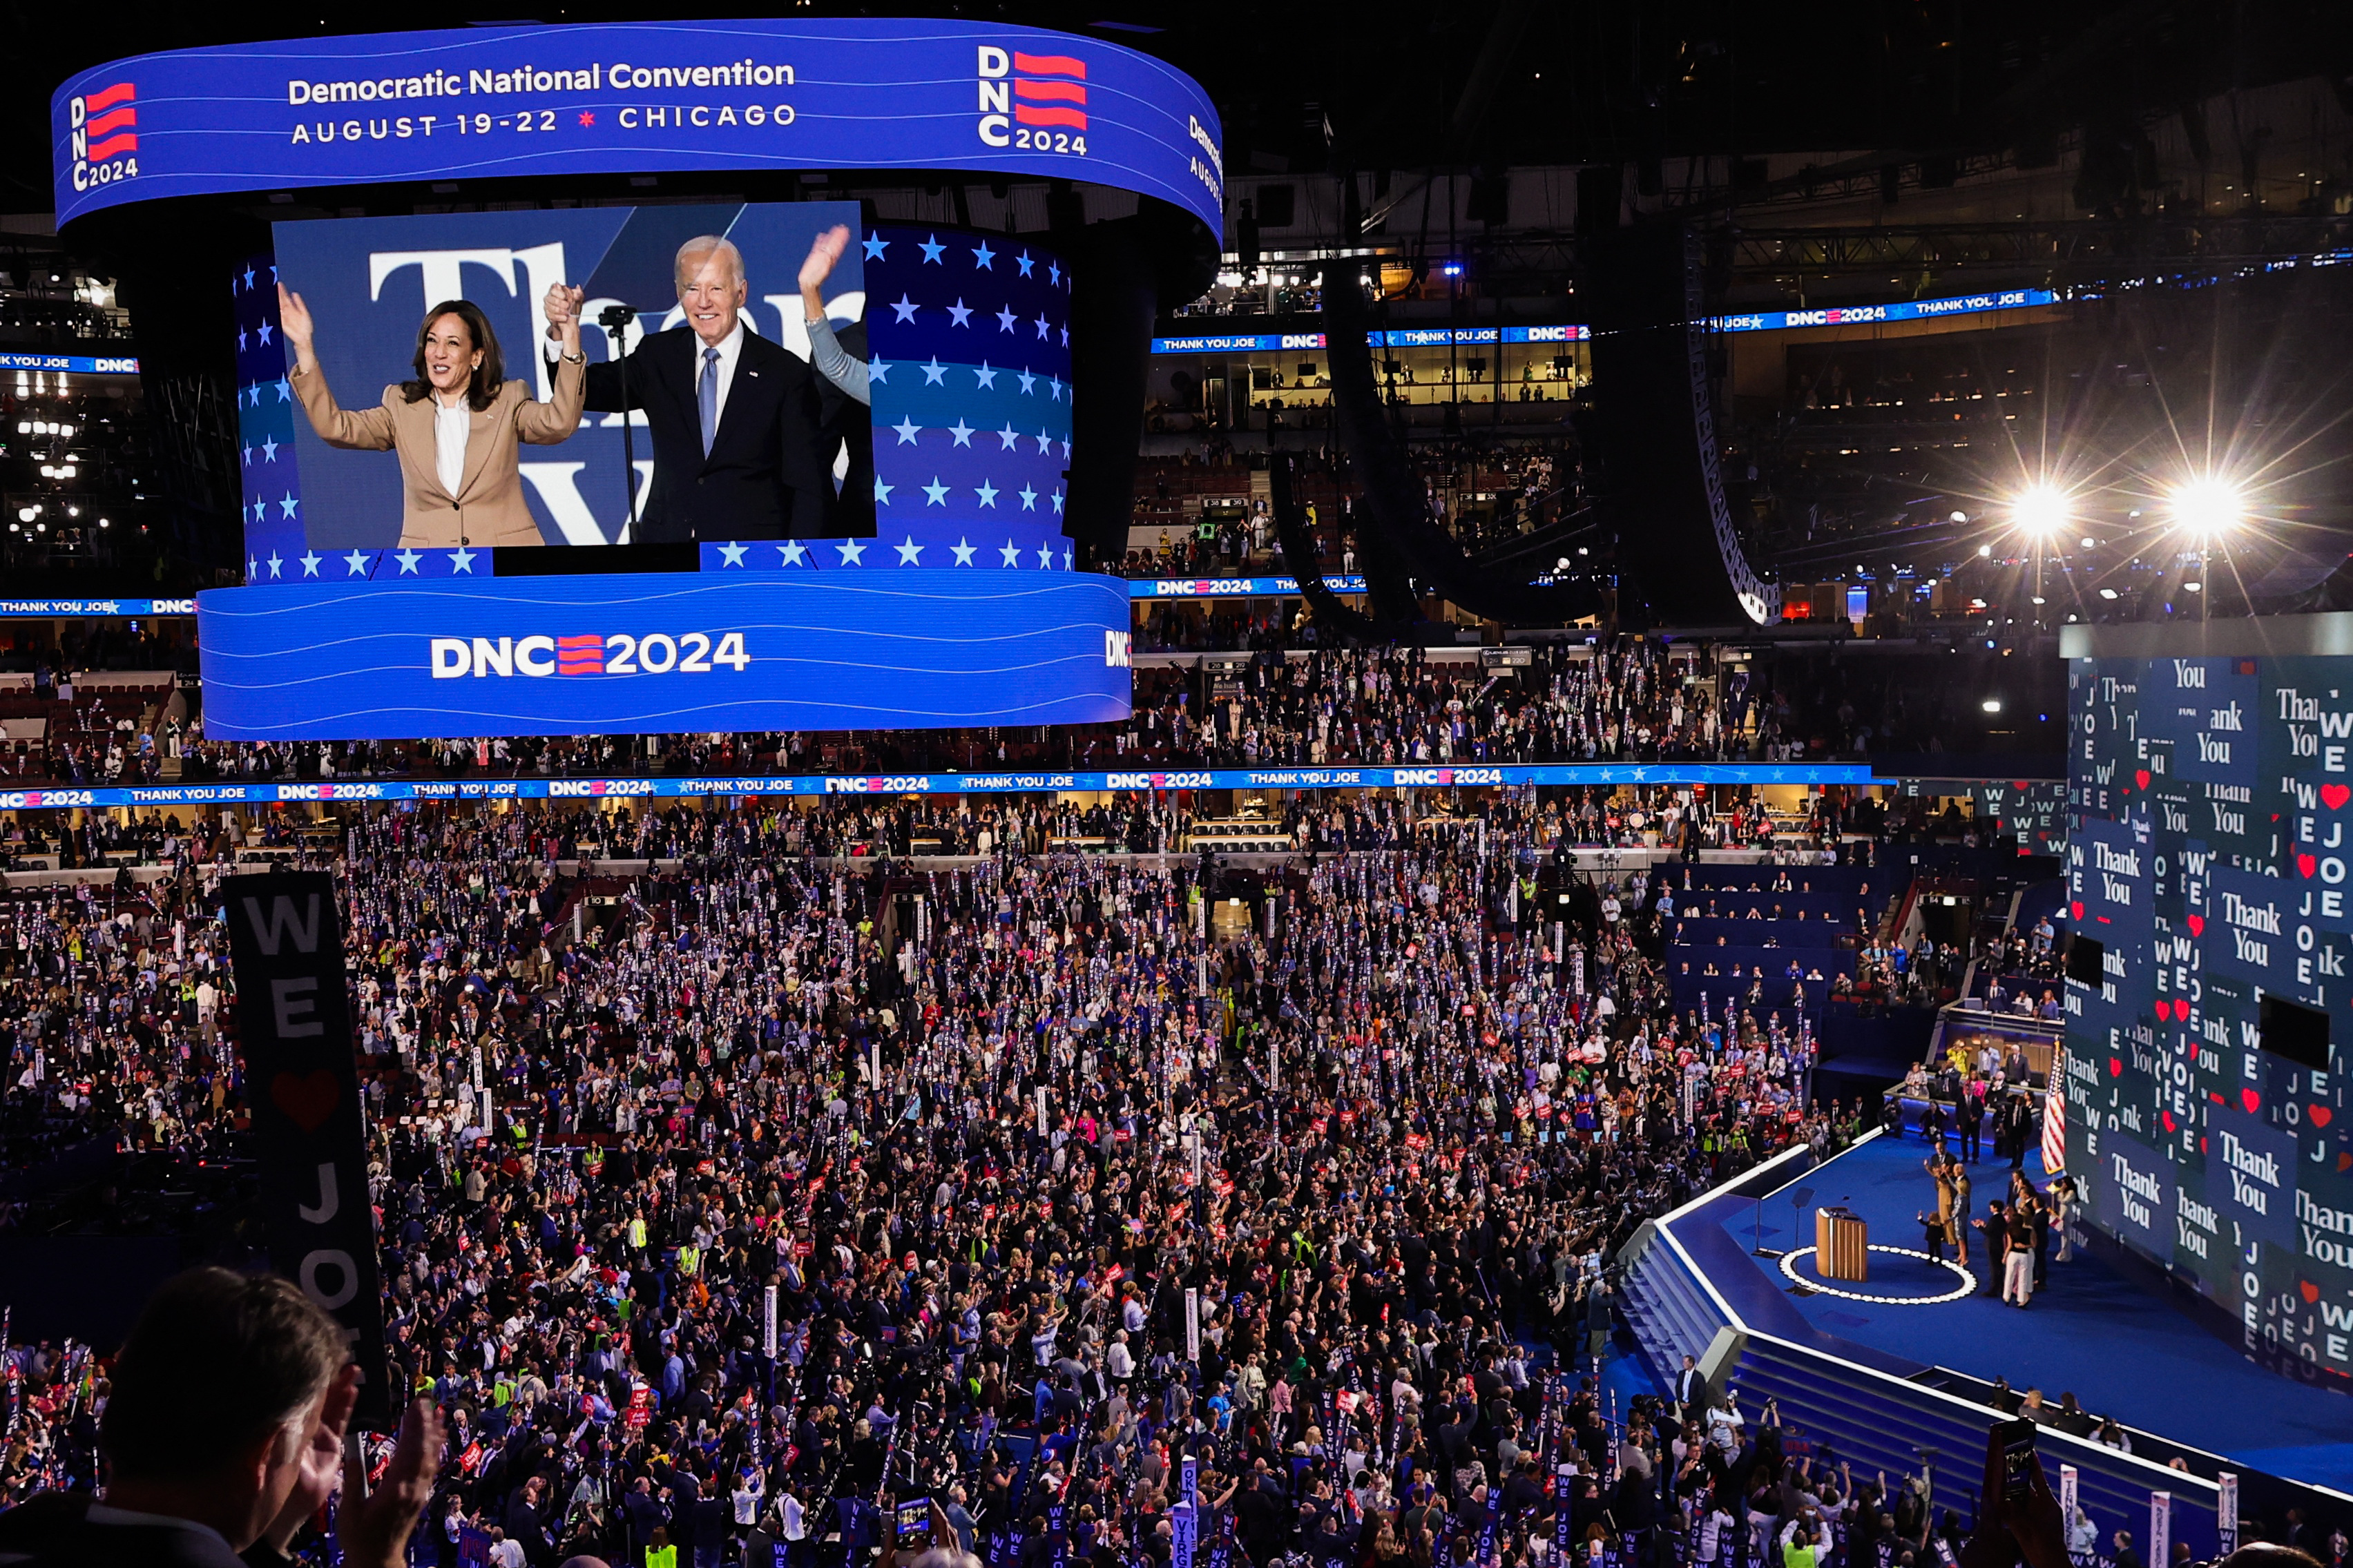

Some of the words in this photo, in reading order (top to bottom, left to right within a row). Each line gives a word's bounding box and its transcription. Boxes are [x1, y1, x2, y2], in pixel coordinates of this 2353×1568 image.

[289, 69, 461, 105] Democratic
[469, 63, 600, 95] National
[608, 58, 794, 89] Convention
[291, 116, 436, 144] AUGUST
[457, 110, 556, 135] 19-22
[619, 104, 795, 128] CHICAGO
[1016, 128, 1087, 156] 2024
[89, 158, 138, 186] 2024
[1725, 317, 1751, 329] JOE
[1786, 311, 1827, 327] DNC
[1916, 300, 1963, 313] THANK
[1998, 293, 2024, 305] JOE
[1164, 339, 1204, 349] THANK
[1205, 338, 1231, 348] YOU
[1232, 338, 1256, 347] JOE
[1282, 334, 1318, 348] DNC
[1405, 331, 1446, 342] THANK
[1475, 330, 1497, 340] JOE
[1528, 327, 1566, 340] DNC
[12, 356, 41, 367] YOU
[44, 358, 69, 368] JOE
[95, 358, 135, 372] DNC
[1156, 580, 1195, 594] DNC
[1209, 579, 1253, 593] 2024
[0, 602, 49, 612] THANK
[51, 601, 82, 612] YOU
[84, 601, 110, 612] JOE
[152, 599, 193, 613] DNC
[431, 635, 555, 679] DNC
[605, 632, 751, 674] 2024
[1105, 630, 1128, 668] DNC
[2173, 659, 2206, 688] You
[2196, 732, 2231, 764] You
[41, 791, 94, 806] 2024
[131, 789, 182, 801] THANK
[184, 788, 215, 800] YOU
[218, 788, 246, 798] JOE
[278, 784, 320, 800] DNC
[332, 784, 378, 798] 2024
[491, 784, 517, 794] JOE
[549, 781, 591, 796] DNC
[605, 780, 651, 795] 2024
[687, 781, 733, 792] THANK
[735, 780, 764, 791] YOU
[766, 780, 793, 791] JOE
[825, 777, 870, 793] DNC
[883, 777, 929, 792] 2024
[966, 777, 1011, 788] THANK
[1014, 776, 1044, 787] YOU
[1046, 776, 1074, 786] JOE
[1106, 773, 1150, 788] DNC
[1165, 773, 1212, 787] 2024
[1249, 773, 1296, 784] THANK
[1298, 772, 1329, 783] YOU
[1332, 772, 1361, 783] JOE
[1394, 769, 1438, 784] DNC
[1454, 768, 1502, 784] 2024
[2211, 800, 2247, 835] You
[2093, 838, 2142, 878] Thank
[2102, 871, 2133, 906] You
[2222, 891, 2281, 937] Thank
[2233, 926, 2271, 967] You
[2219, 1130, 2280, 1190] Thank
[2111, 1152, 2161, 1207] Thank
[2229, 1166, 2269, 1215] You
[2120, 1185, 2151, 1230] You
[2176, 1214, 2210, 1259] You
